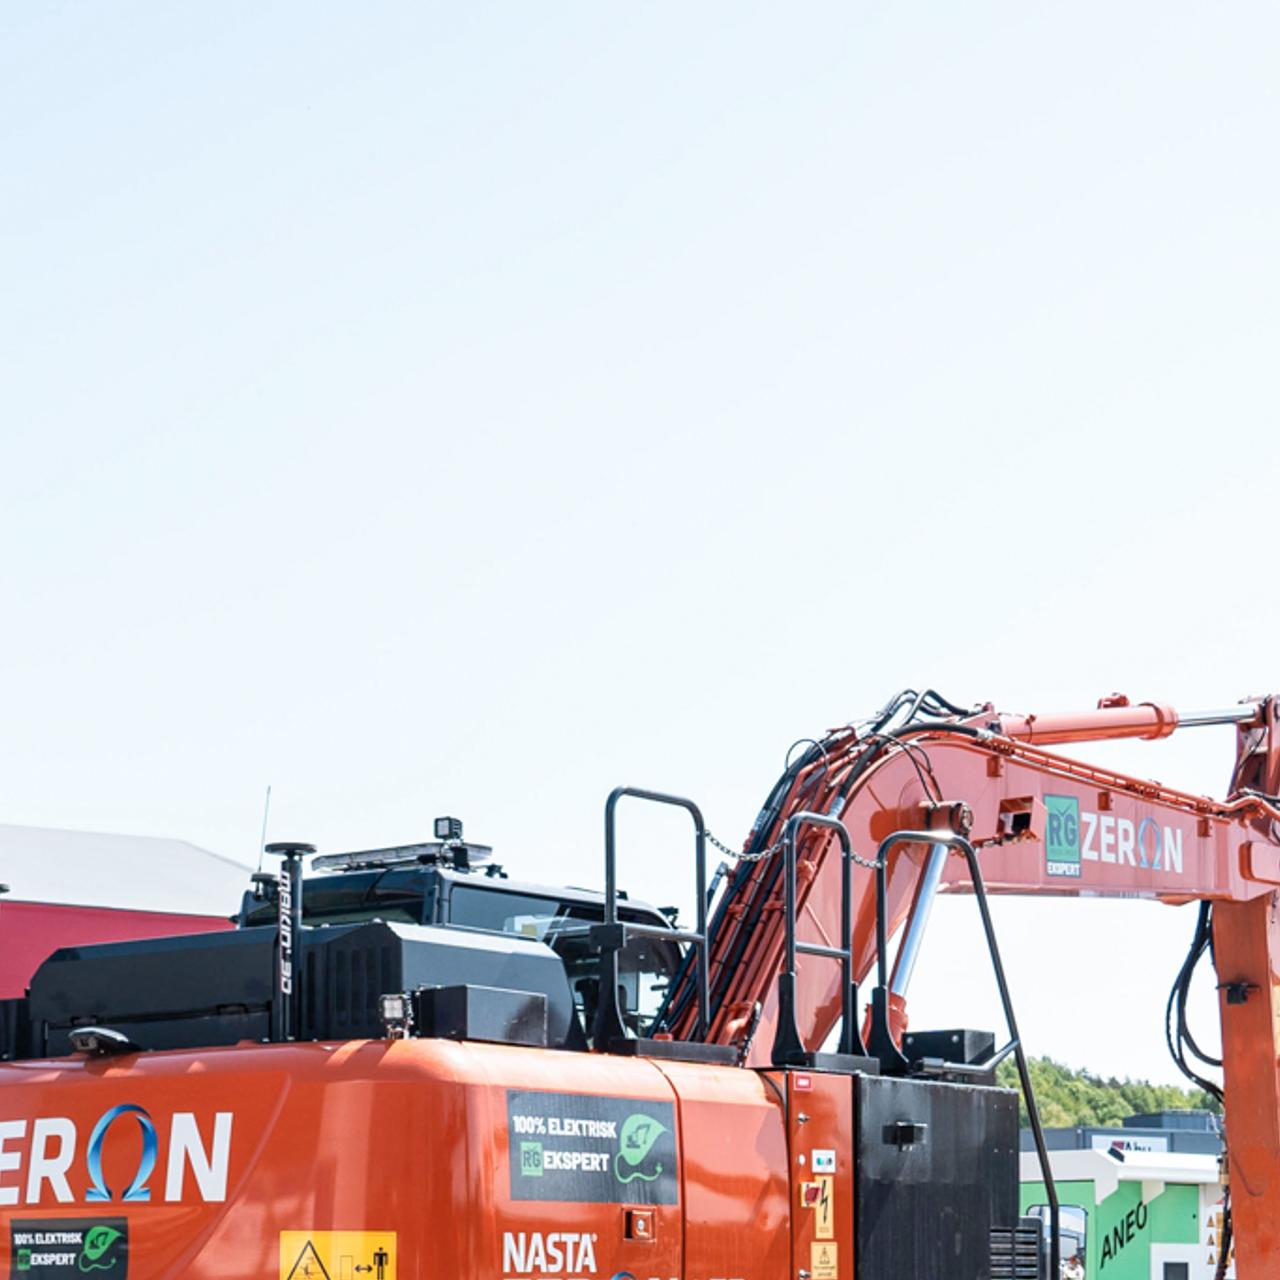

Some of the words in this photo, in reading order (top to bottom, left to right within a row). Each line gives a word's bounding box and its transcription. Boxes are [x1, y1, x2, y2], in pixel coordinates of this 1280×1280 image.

[513, 1115, 546, 1134] 100%
[548, 1118, 617, 1139] ELEKTRISK
[544, 1150, 610, 1171] EKSPERT
[1100, 1201, 1148, 1270] ANEO
[31, 1253, 76, 1266] EKSPERT
